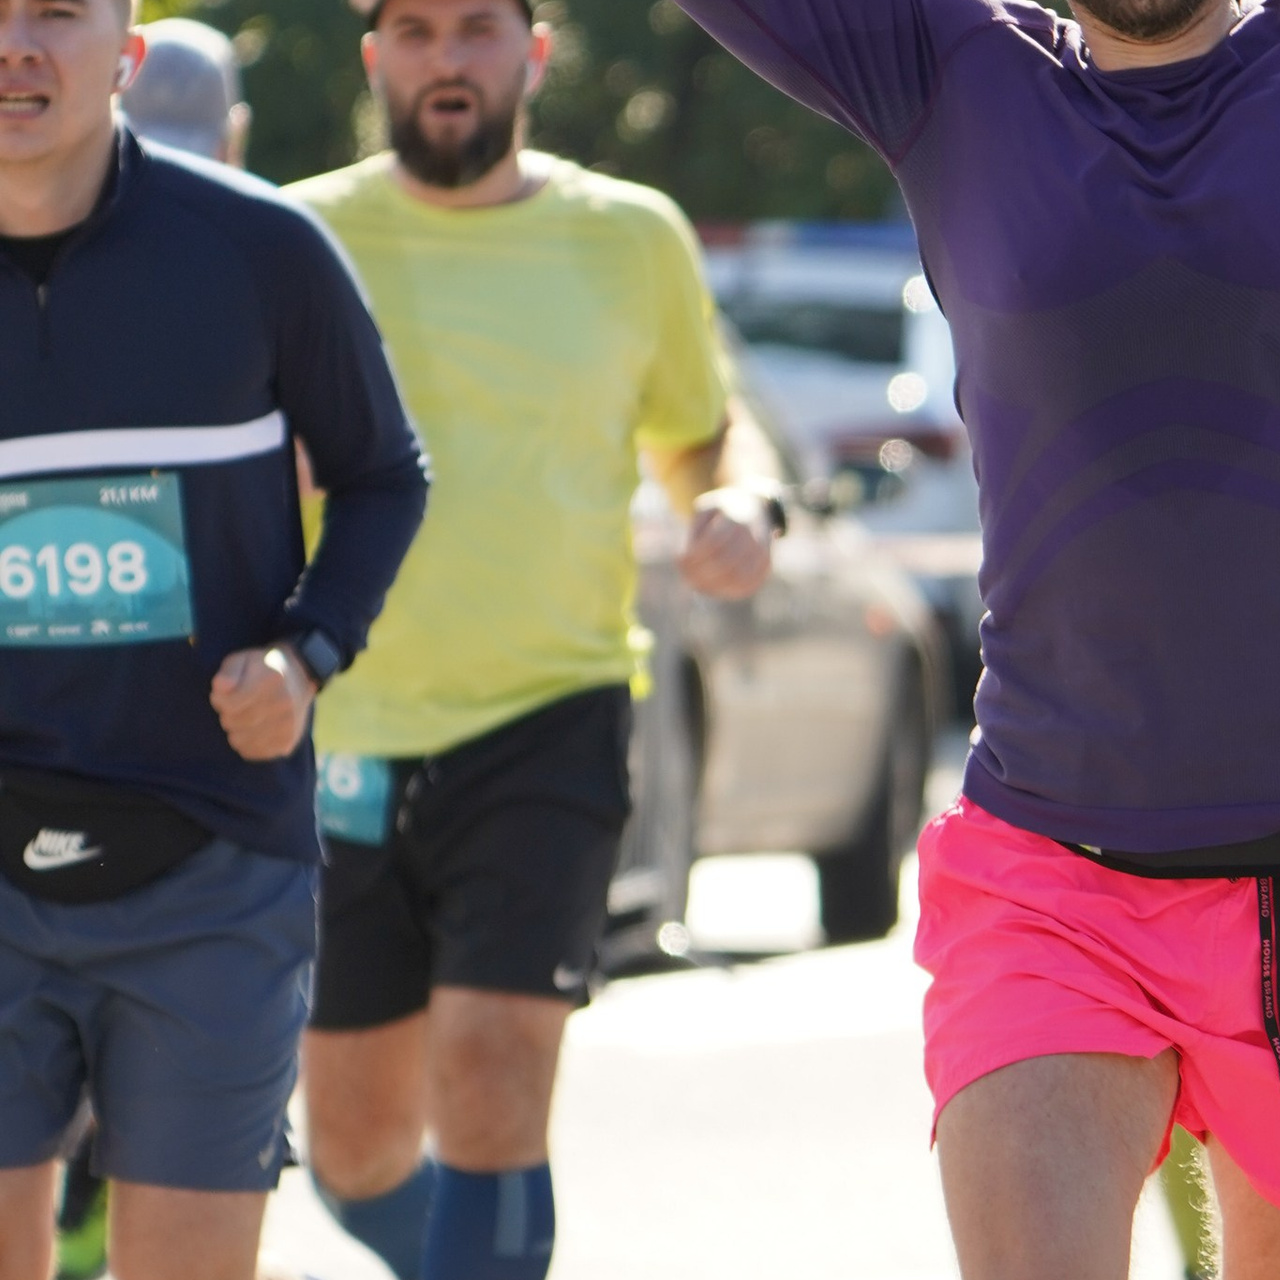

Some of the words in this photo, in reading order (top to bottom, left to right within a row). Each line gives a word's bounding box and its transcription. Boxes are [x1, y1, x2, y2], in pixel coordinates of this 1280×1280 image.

[129, 485, 159, 503] KM
[0, 541, 148, 599] 6198
[33, 827, 84, 855] NIKE
[1259, 878, 1270, 918] BRAND
[1262, 939, 1271, 978] HOUSE
[1263, 980, 1274, 1019] BRAND
